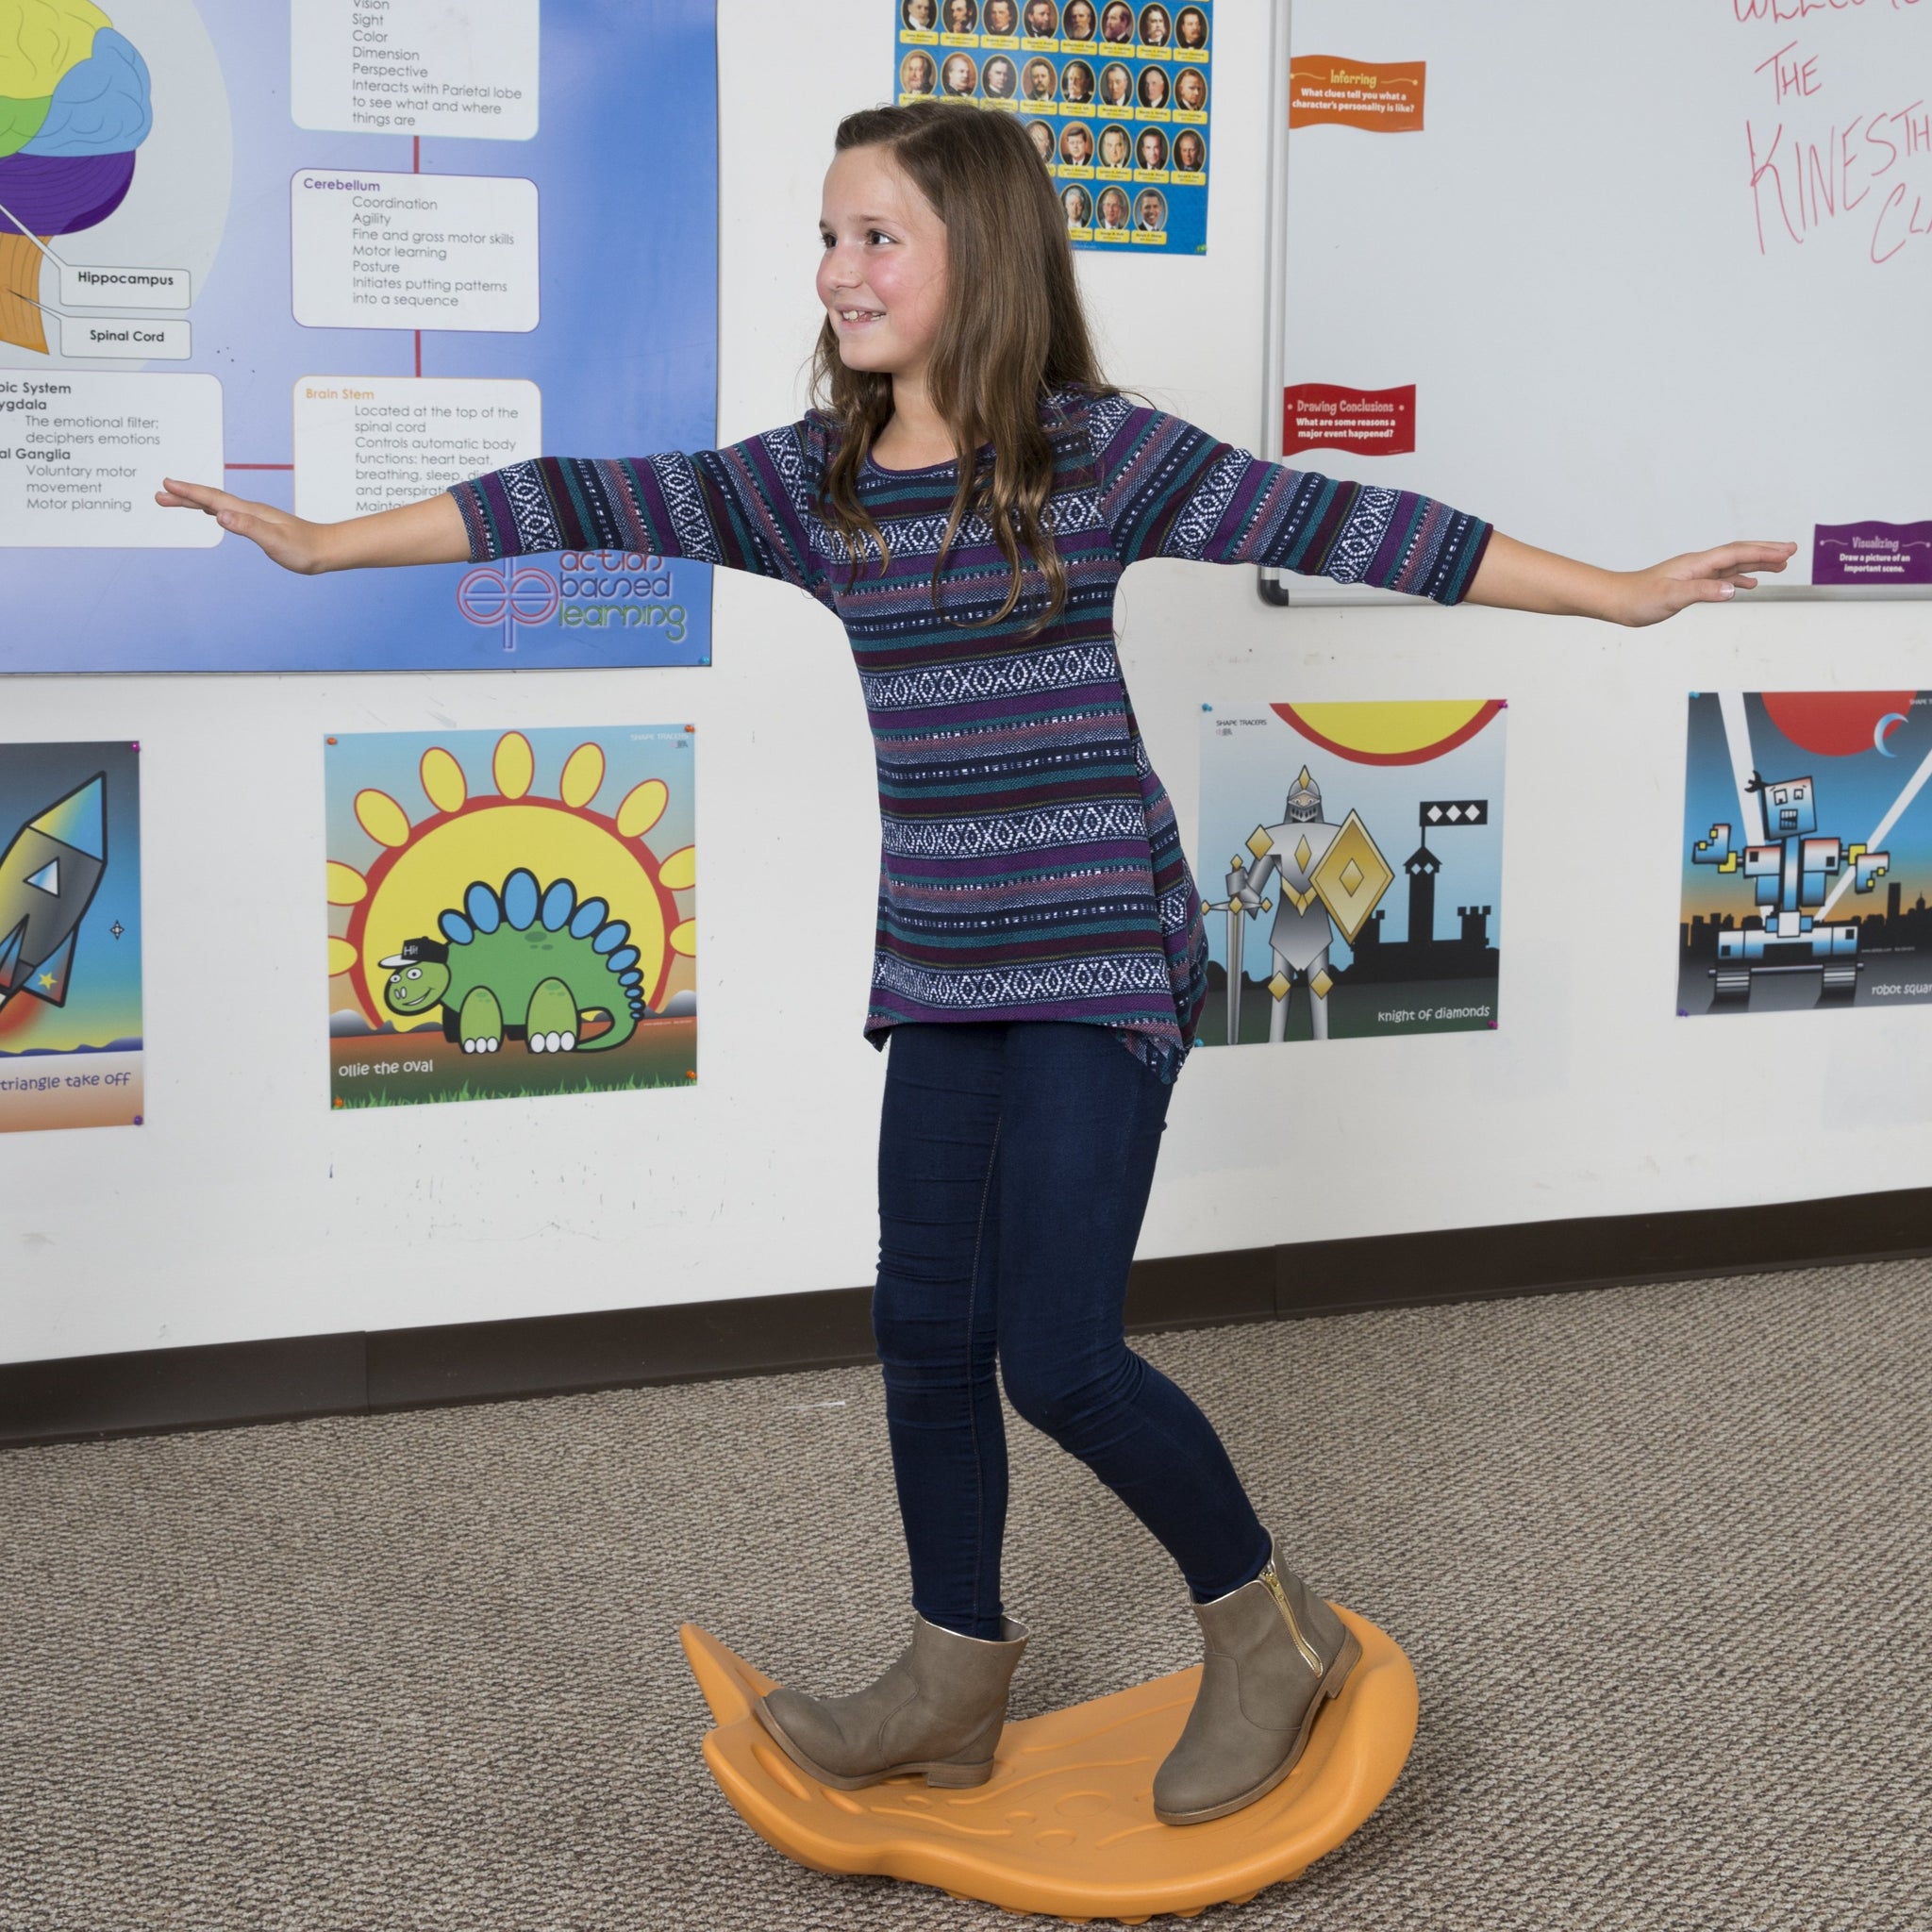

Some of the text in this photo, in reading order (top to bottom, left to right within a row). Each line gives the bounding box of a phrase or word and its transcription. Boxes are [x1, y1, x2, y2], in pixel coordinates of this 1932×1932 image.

[352, 13, 384, 27] Sight
[353, 30, 388, 42] Color
[353, 47, 420, 60] Dimension
[353, 63, 428, 78] Perspective
[1755, 40, 1823, 106] THE
[1330, 69, 1377, 90] Inferring
[353, 80, 523, 99] Interacts with Parietal lobe
[1301, 88, 1407, 101] What clues tell you what a
[353, 96, 502, 114] to see what and where
[1338, 101, 1386, 113] personality
[1387, 102, 1394, 112] is
[1394, 103, 1415, 113] like?
[353, 113, 416, 127] things are
[303, 177, 380, 192] Cerebellum
[352, 195, 438, 210] Coordination
[352, 212, 391, 226] Agility
[353, 228, 515, 245] Fine and gross motor skills
[353, 245, 447, 260] Motor learning
[353, 260, 401, 274] Posture
[77, 271, 175, 288] Hippocampus
[353, 276, 508, 293] Initiates putting patterns
[353, 292, 459, 308] into a sequence
[90, 329, 165, 342] Spinal Cord
[23, 382, 72, 395] System
[306, 388, 375, 400] Brain Stem
[355, 405, 519, 420] Located at the top of the
[1296, 398, 1394, 416] Drawing Conclusions
[25, 415, 49, 427] The
[53, 415, 124, 428] emotional
[355, 421, 426, 434] spinal cord
[1296, 418, 1318, 426] What
[1357, 418, 1390, 426] reasons
[25, 431, 160, 446] deciphers emotions
[1297, 428, 1394, 440] major event happened?
[355, 437, 517, 452] Controls automatic body
[15, 448, 71, 462] Ganglia
[355, 453, 418, 465] functions:
[421, 454, 456, 465] heart
[25, 464, 137, 479] Voluntary motor
[26, 482, 102, 493] movement
[356, 485, 382, 496] and
[26, 498, 132, 512] Motor planning
[1852, 535, 1899, 553] Visualizing
[559, 549, 662, 572] action
[1839, 553, 1859, 561] Draw
[1865, 554, 1891, 563] picture
[1891, 553, 1901, 561] of
[1843, 564, 1906, 574] important scene.
[559, 571, 671, 598] based
[558, 598, 686, 641] learning
[1872, 984, 1902, 996] robot
[1377, 1009, 1415, 1024] knight
[1435, 1005, 1491, 1020] diamonds
[373, 1061, 399, 1075] the
[403, 1058, 434, 1073] oval
[0, 1072, 131, 1091] triangle take off
